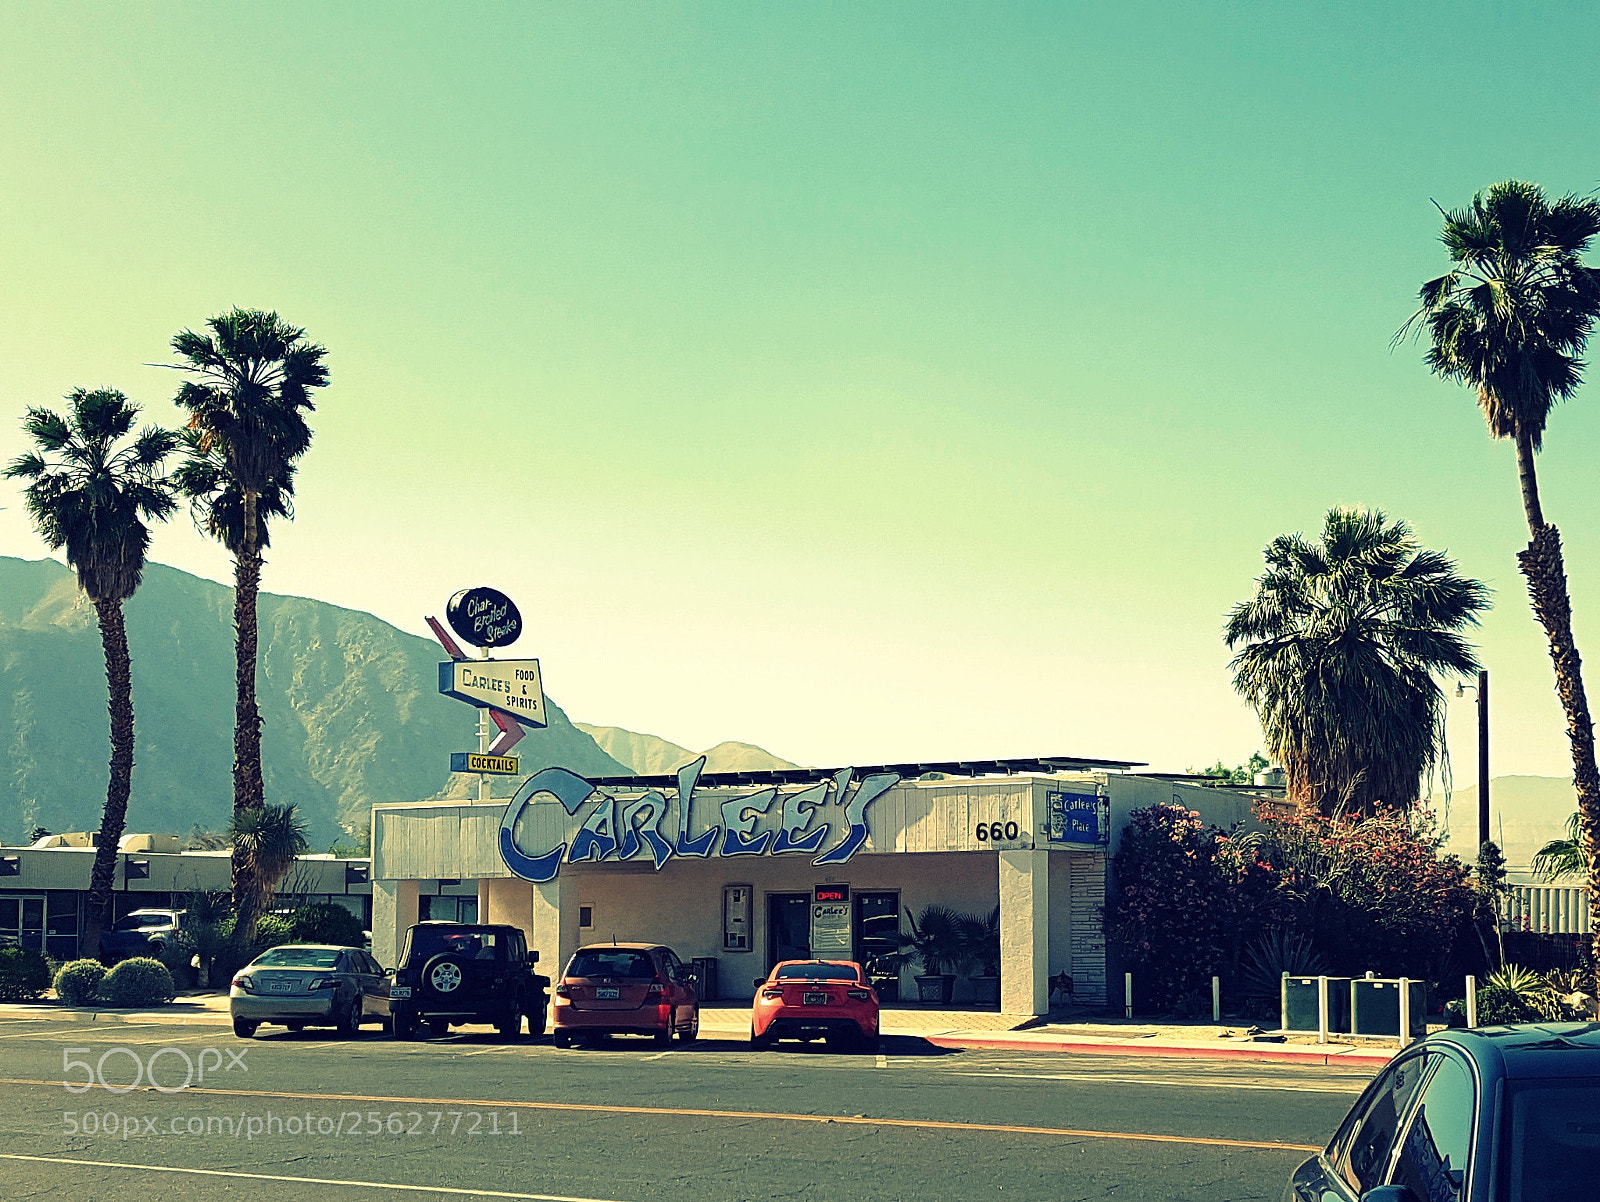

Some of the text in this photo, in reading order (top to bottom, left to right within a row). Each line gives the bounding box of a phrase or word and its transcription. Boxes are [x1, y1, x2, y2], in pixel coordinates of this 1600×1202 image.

[515, 669, 535, 681] FOOD
[521, 684, 527, 695] &
[506, 695, 537, 710] SPIRITS
[471, 756, 514, 771] COCKTAILS
[1064, 798, 1097, 815] Carlee's
[976, 820, 1018, 841] 660
[817, 892, 842, 901] OPEN
